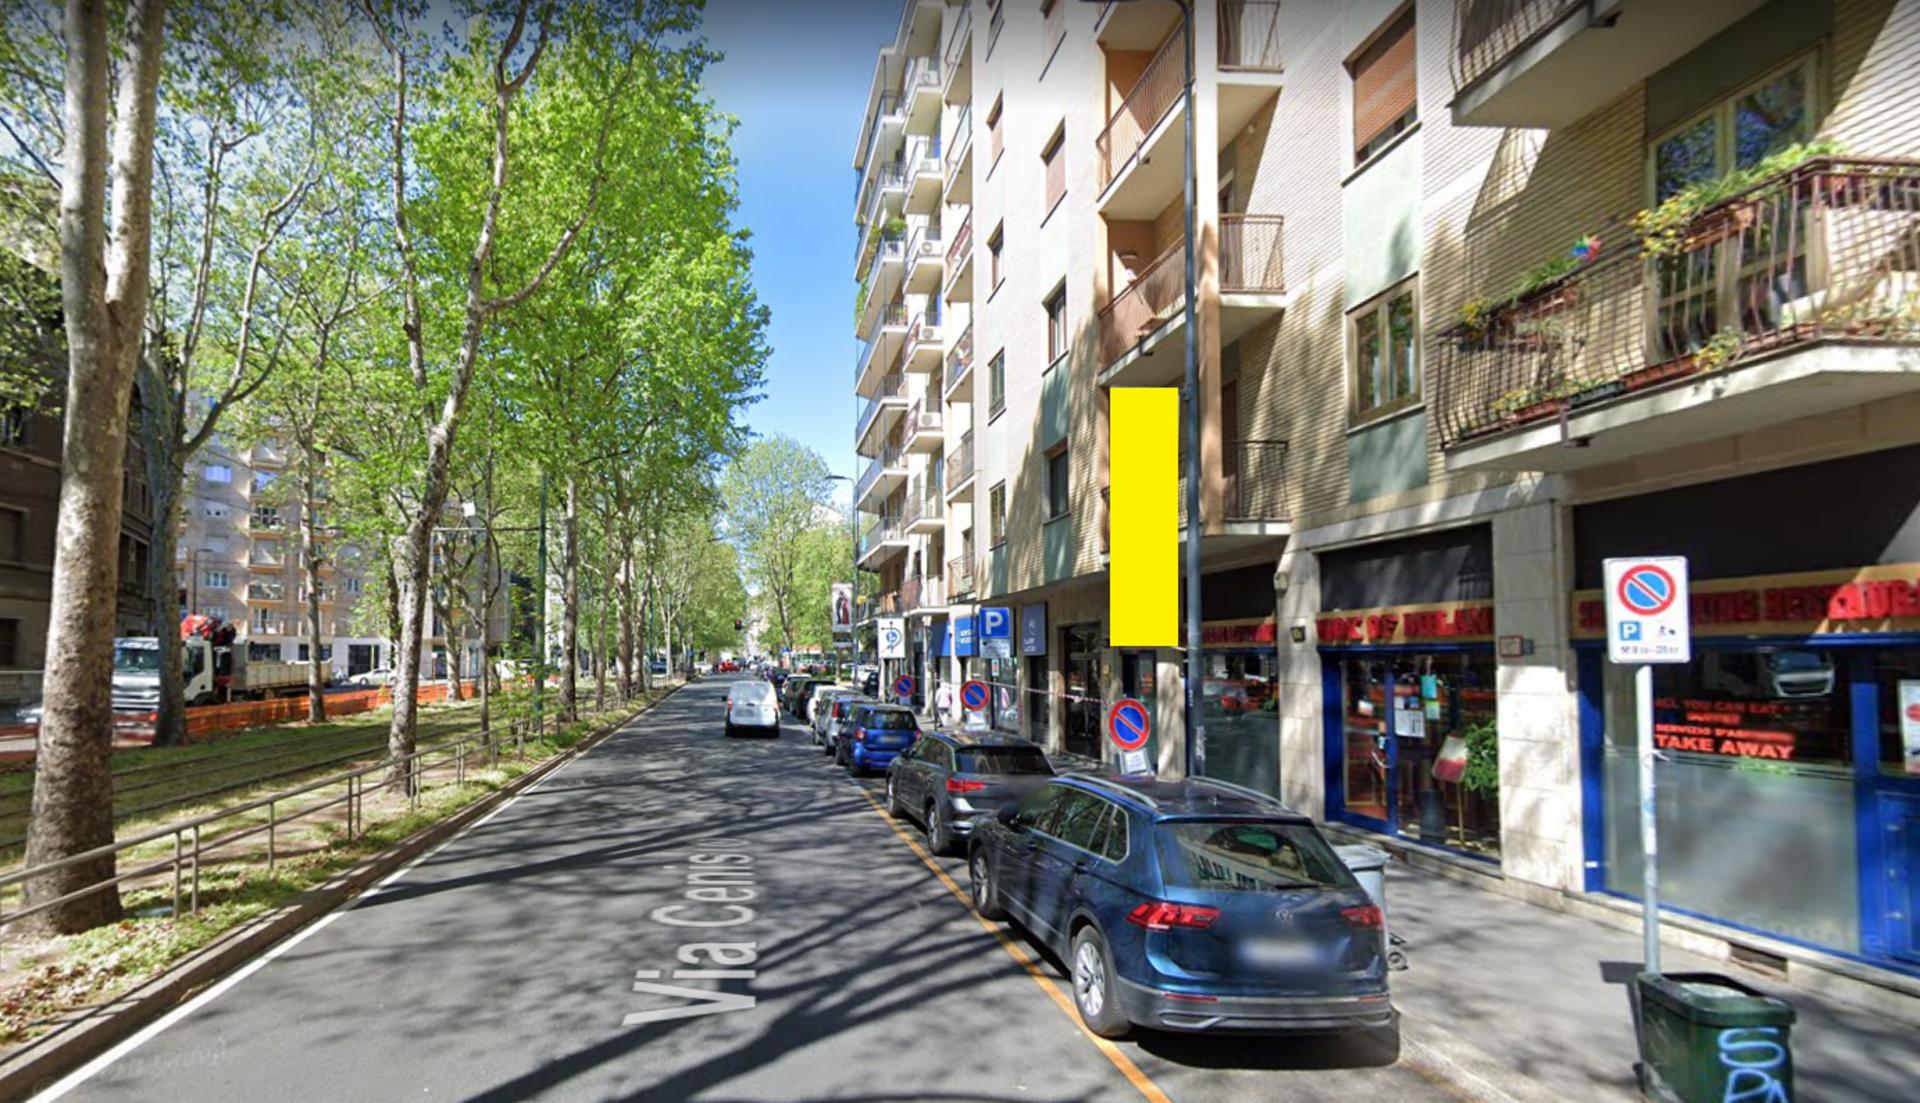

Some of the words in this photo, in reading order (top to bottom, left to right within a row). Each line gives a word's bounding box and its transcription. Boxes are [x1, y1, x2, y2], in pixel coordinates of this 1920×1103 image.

[985, 611, 1004, 635] P
[1622, 623, 1638, 641] P
[1654, 734, 1714, 752] TAKE
[1720, 740, 1795, 760] AWAY
